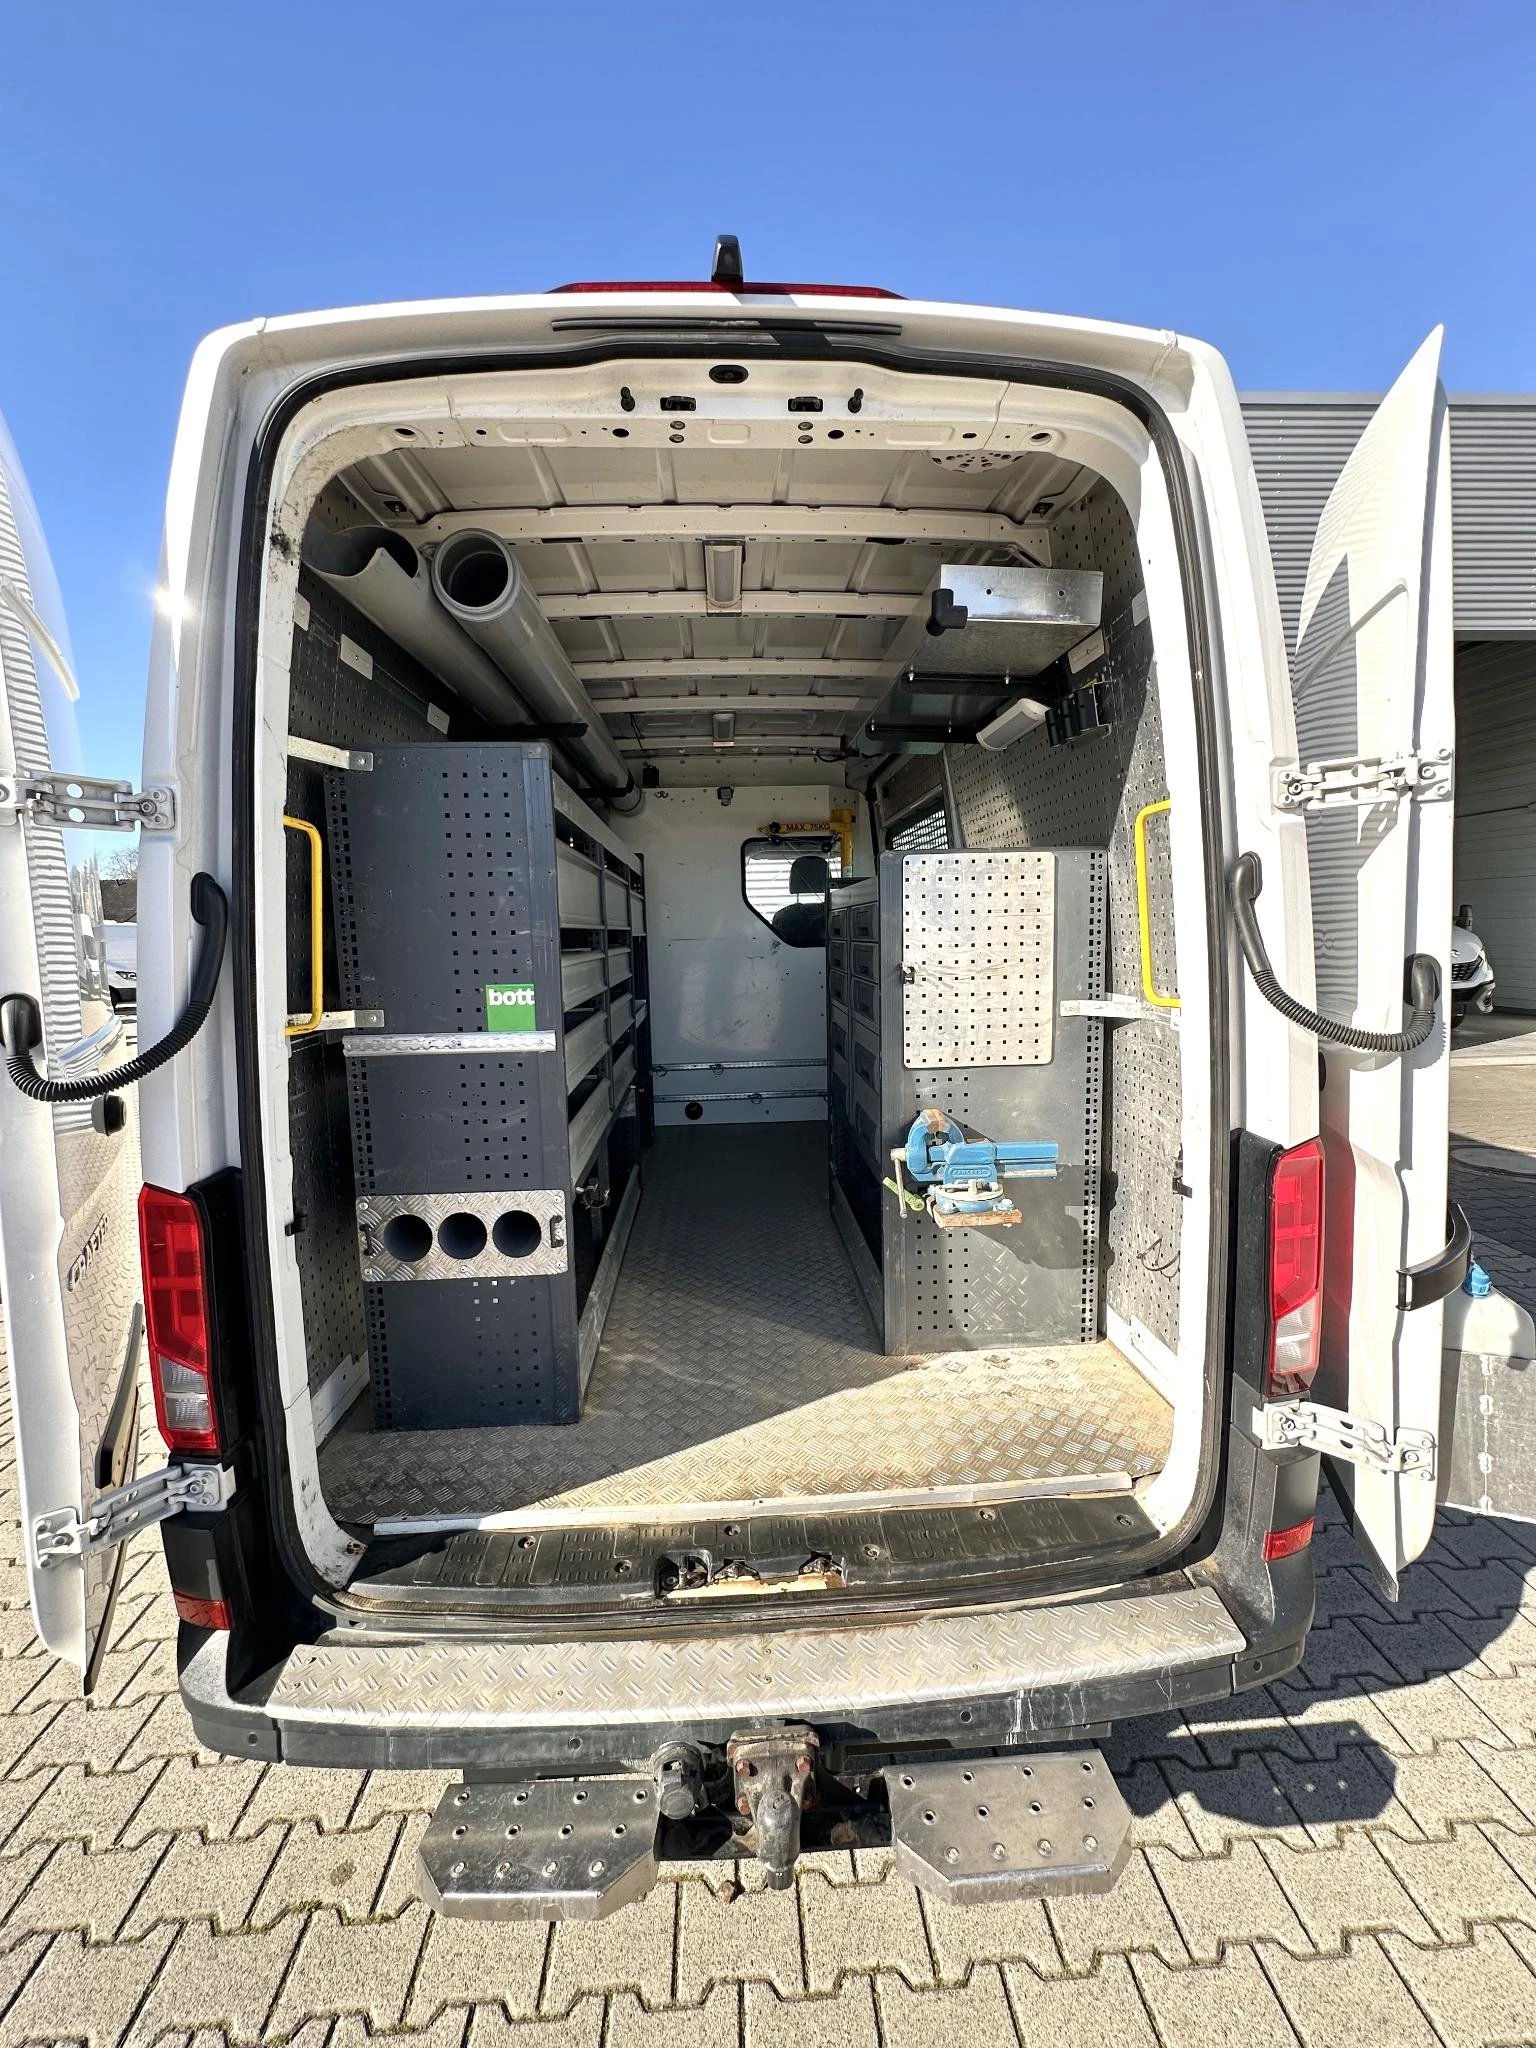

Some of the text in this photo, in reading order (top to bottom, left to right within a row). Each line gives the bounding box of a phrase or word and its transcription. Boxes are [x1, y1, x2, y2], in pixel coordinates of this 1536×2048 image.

[786, 823, 831, 832] MAX. 75KG
[488, 988, 535, 1006] bott
